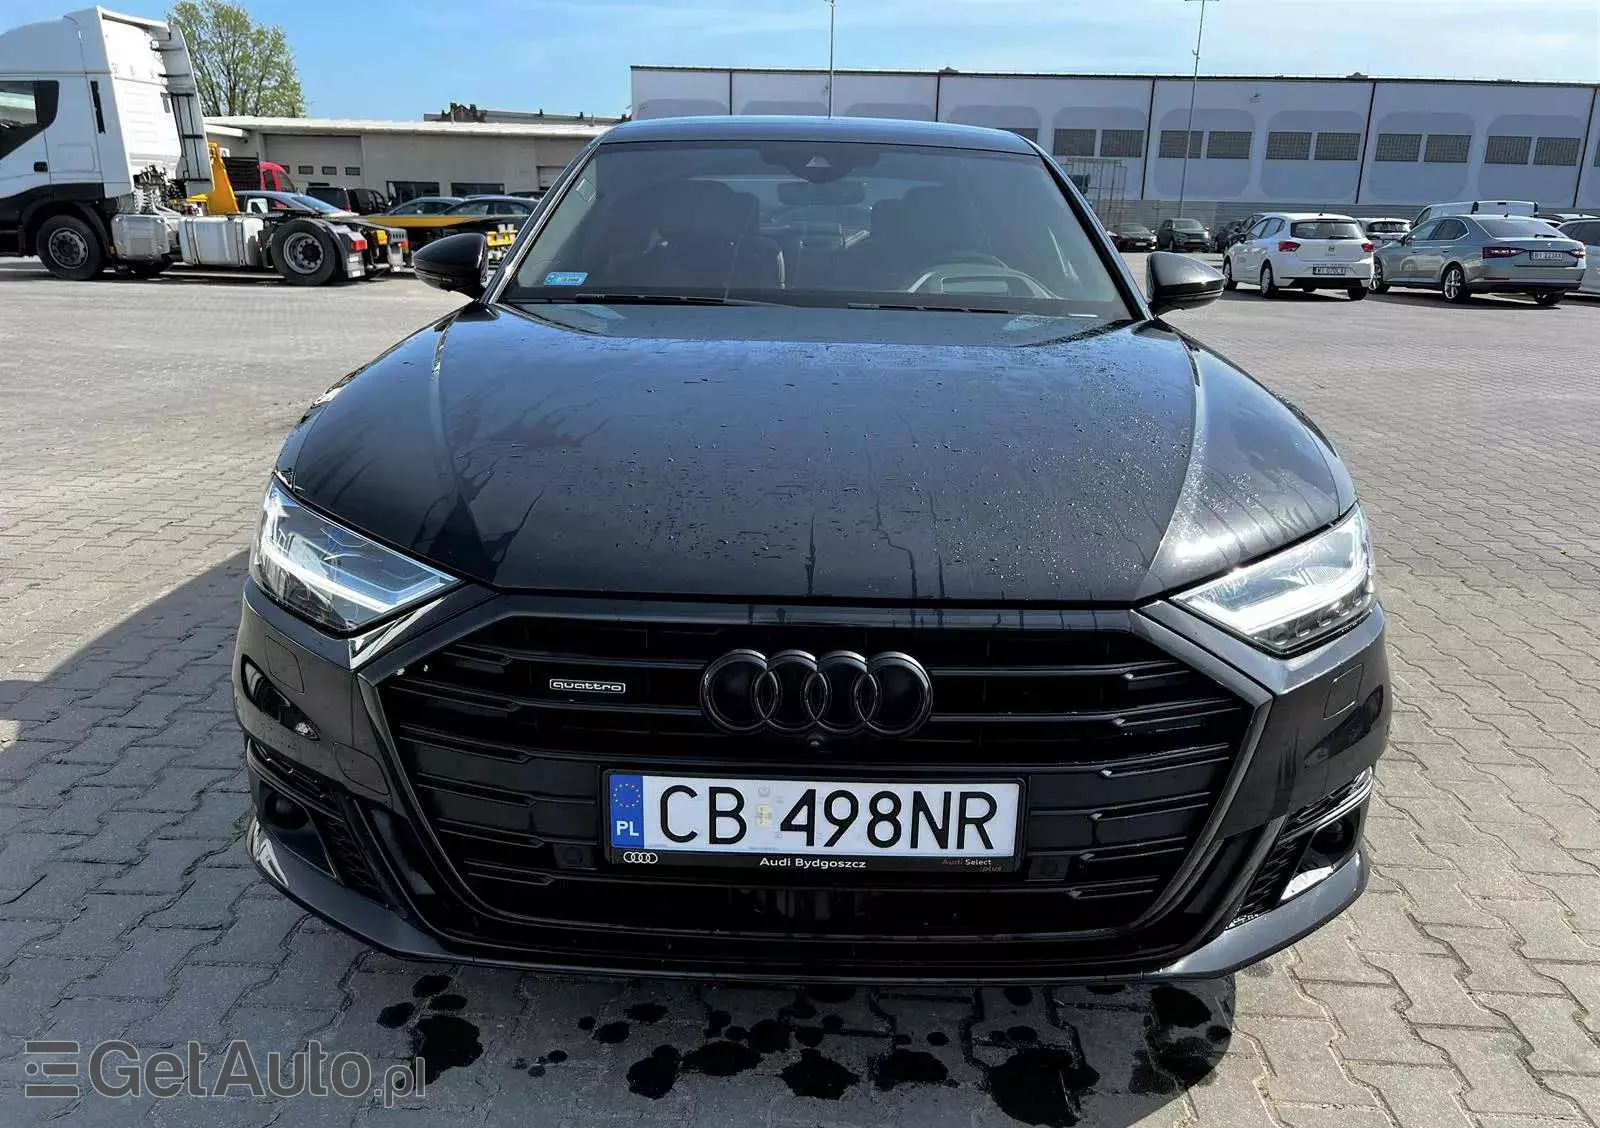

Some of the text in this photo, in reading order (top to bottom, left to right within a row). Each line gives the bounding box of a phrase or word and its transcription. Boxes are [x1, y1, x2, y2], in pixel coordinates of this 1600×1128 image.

[552, 681, 622, 691] quattro
[659, 784, 998, 850] CB 498NR
[616, 820, 639, 837] PL
[759, 857, 867, 870] Audi Bydgoszcz
[965, 858, 992, 866] Select
